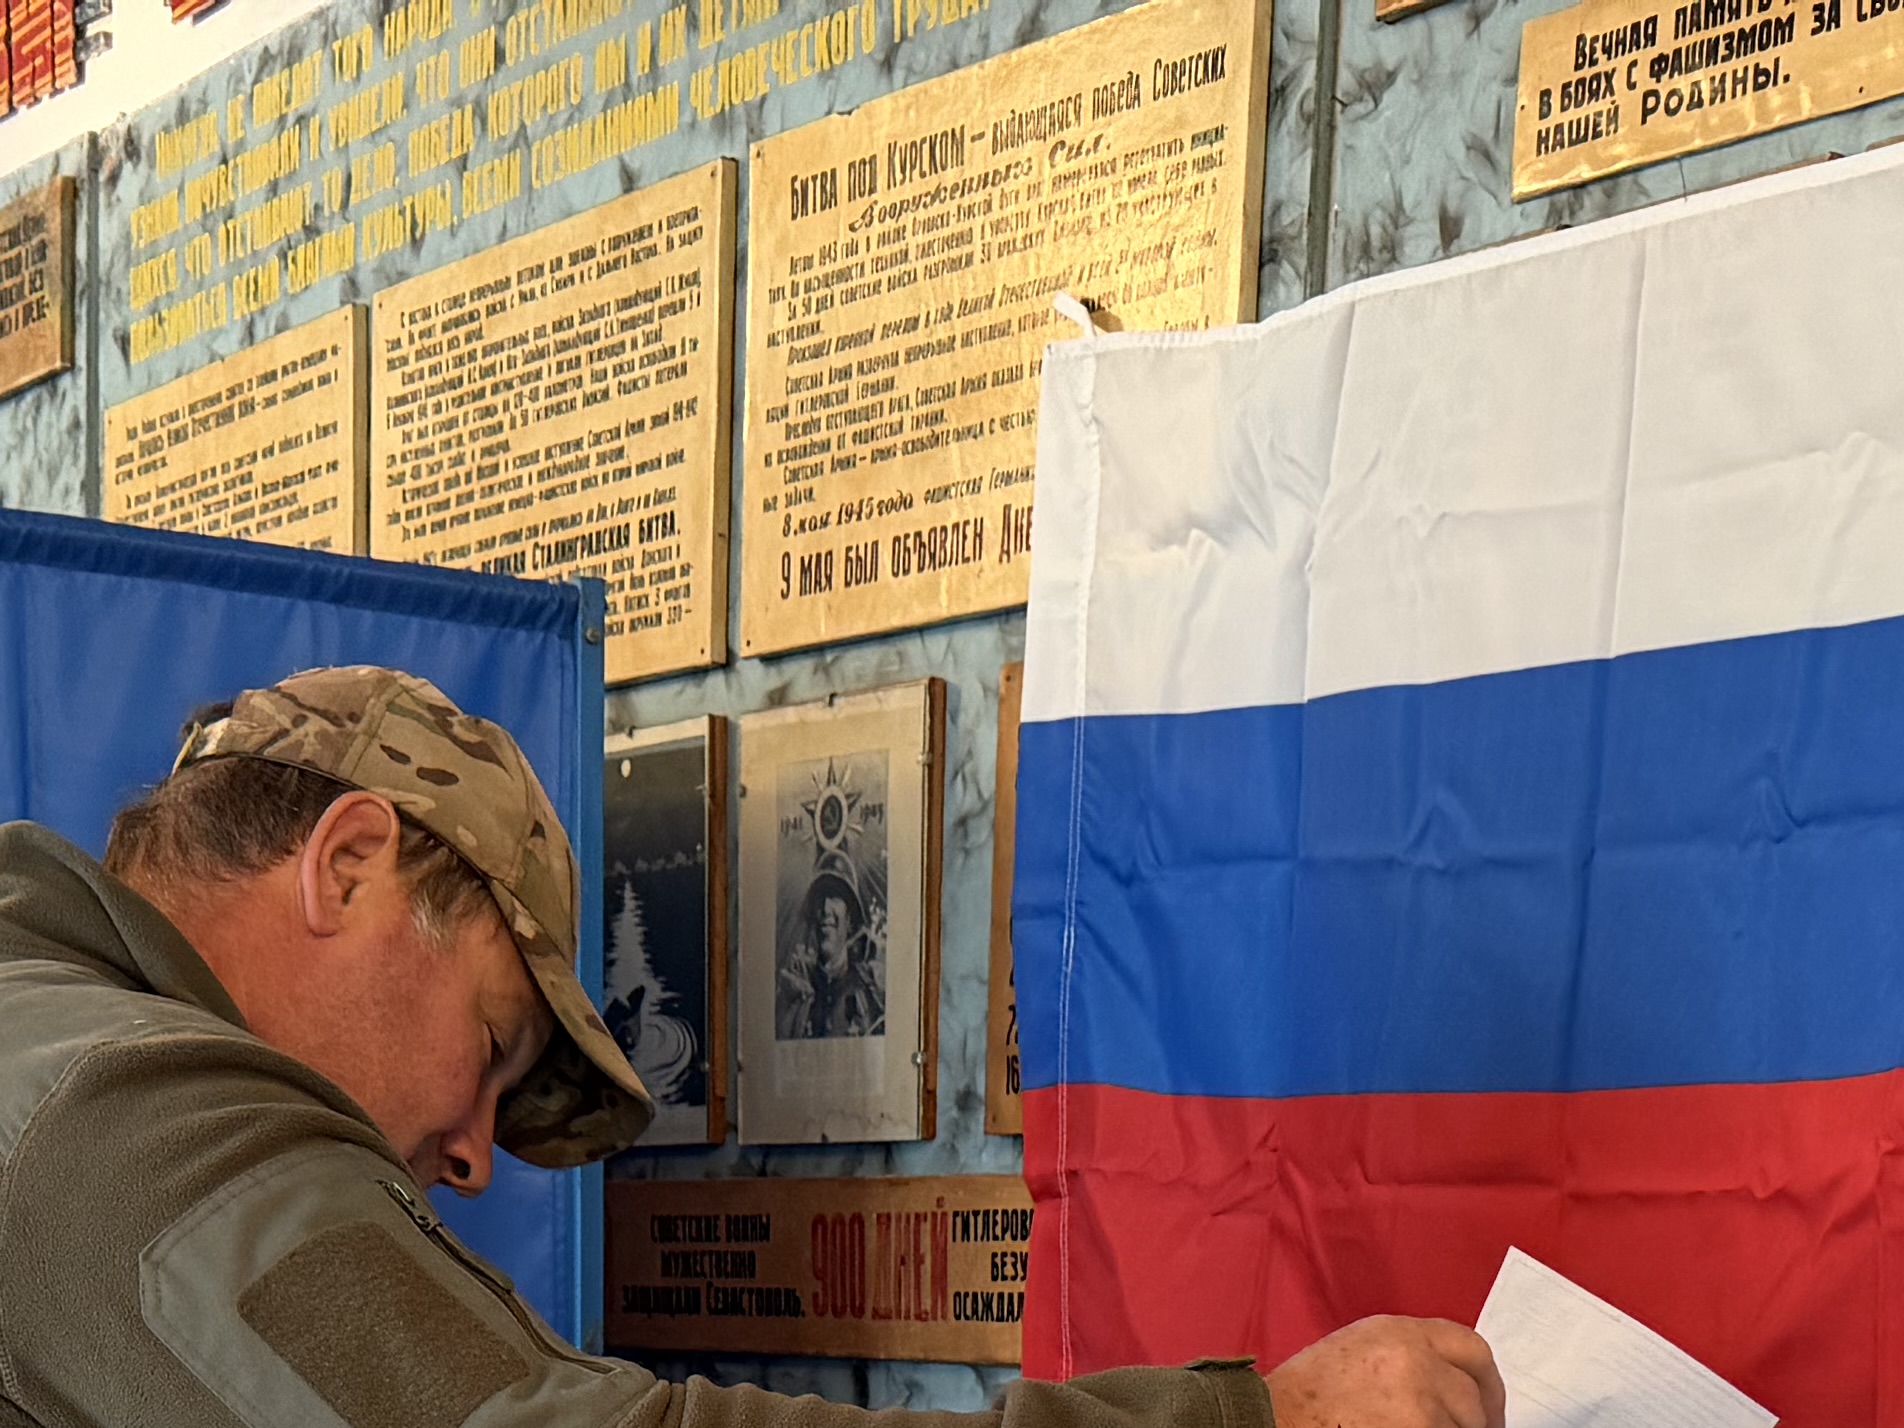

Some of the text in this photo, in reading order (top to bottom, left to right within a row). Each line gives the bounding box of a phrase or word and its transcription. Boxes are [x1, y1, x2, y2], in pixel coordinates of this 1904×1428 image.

[416, 49, 449, 107] ЧТО
[459, 25, 495, 88] ОНИ
[1151, 42, 1228, 102] Советских
[1536, 56, 1790, 157] НАШЕЙ РОДИНЫ.
[1538, 87, 1552, 120] В
[1560, 72, 1616, 117] БОЯХ
[1626, 60, 1637, 90] С
[1649, 11, 1796, 83] ФАШИЗМОМ
[1810, 2, 1841, 36] ЗА
[323, 168, 342, 216] ТО
[408, 103, 475, 177] ПОБЕДА
[488, 53, 583, 141] КОТОРОГО
[637, 20, 651, 76] И
[659, 4, 687, 67] ИХ
[462, 148, 521, 219] ВСЕМИ
[690, 4, 877, 120] ЧЕЛОВЕЧЕСКОГО
[818, 239, 837, 267] 1943
[780, 551, 791, 601] 9
[798, 549, 833, 597] МАЯ
[843, 539, 879, 588] БЫЛ
[661, 1250, 757, 1279] МУЖЕСТВЕННО
[811, 1196, 949, 1321] 900 ДНЕЙ
